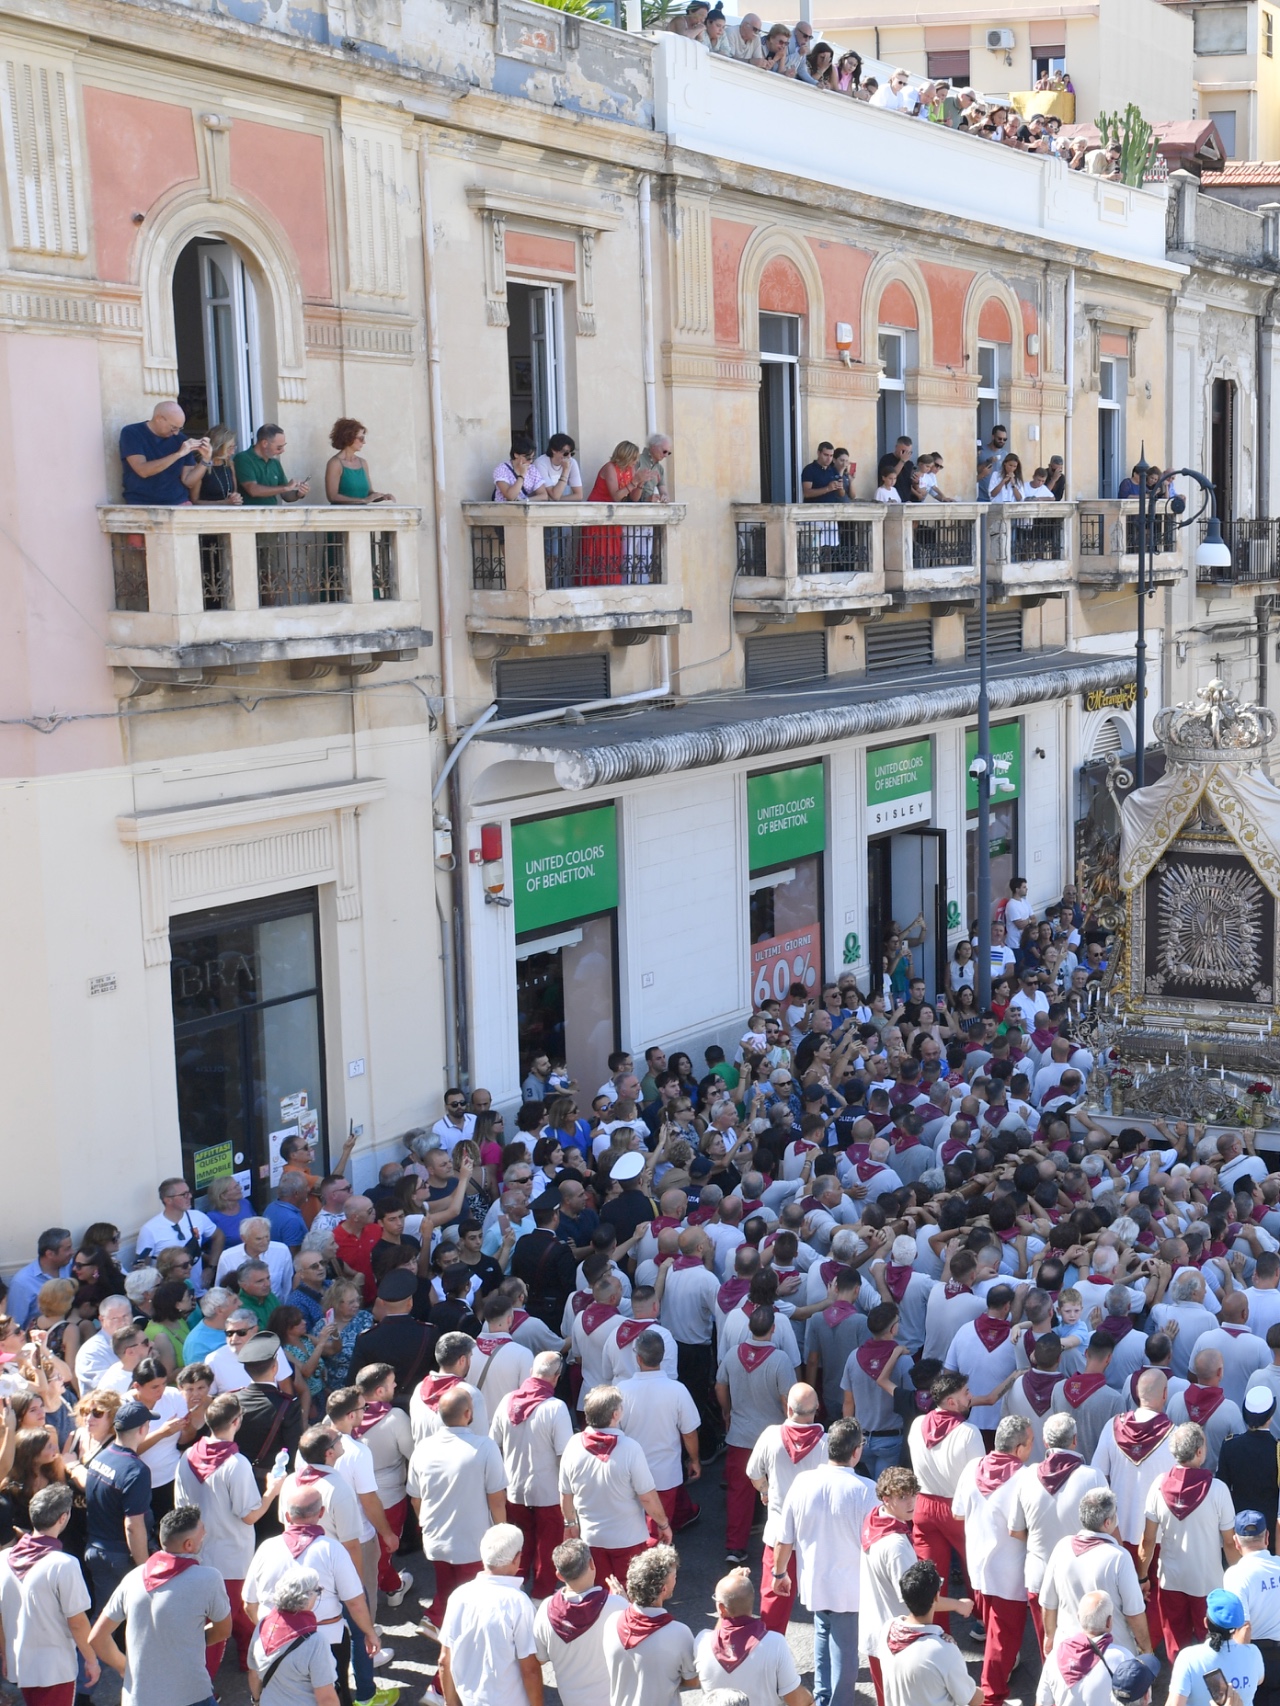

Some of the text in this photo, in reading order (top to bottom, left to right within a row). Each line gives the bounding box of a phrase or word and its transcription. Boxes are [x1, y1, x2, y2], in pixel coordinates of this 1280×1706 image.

[874, 756, 924, 778] UNITED COLORS
[874, 778, 885, 791] OF
[757, 796, 815, 821] UNITED COLORS
[876, 802, 923, 823] SISLEY
[757, 813, 809, 836] OF BENETTON.
[525, 845, 605, 875] UNITED COLORS
[526, 864, 596, 892] OF BENETTON.
[755, 934, 812, 961] ULTIMI GIORNI
[196, 1162, 232, 1179] IMMOBILE
[200, 1153, 227, 1168] QUESTO
